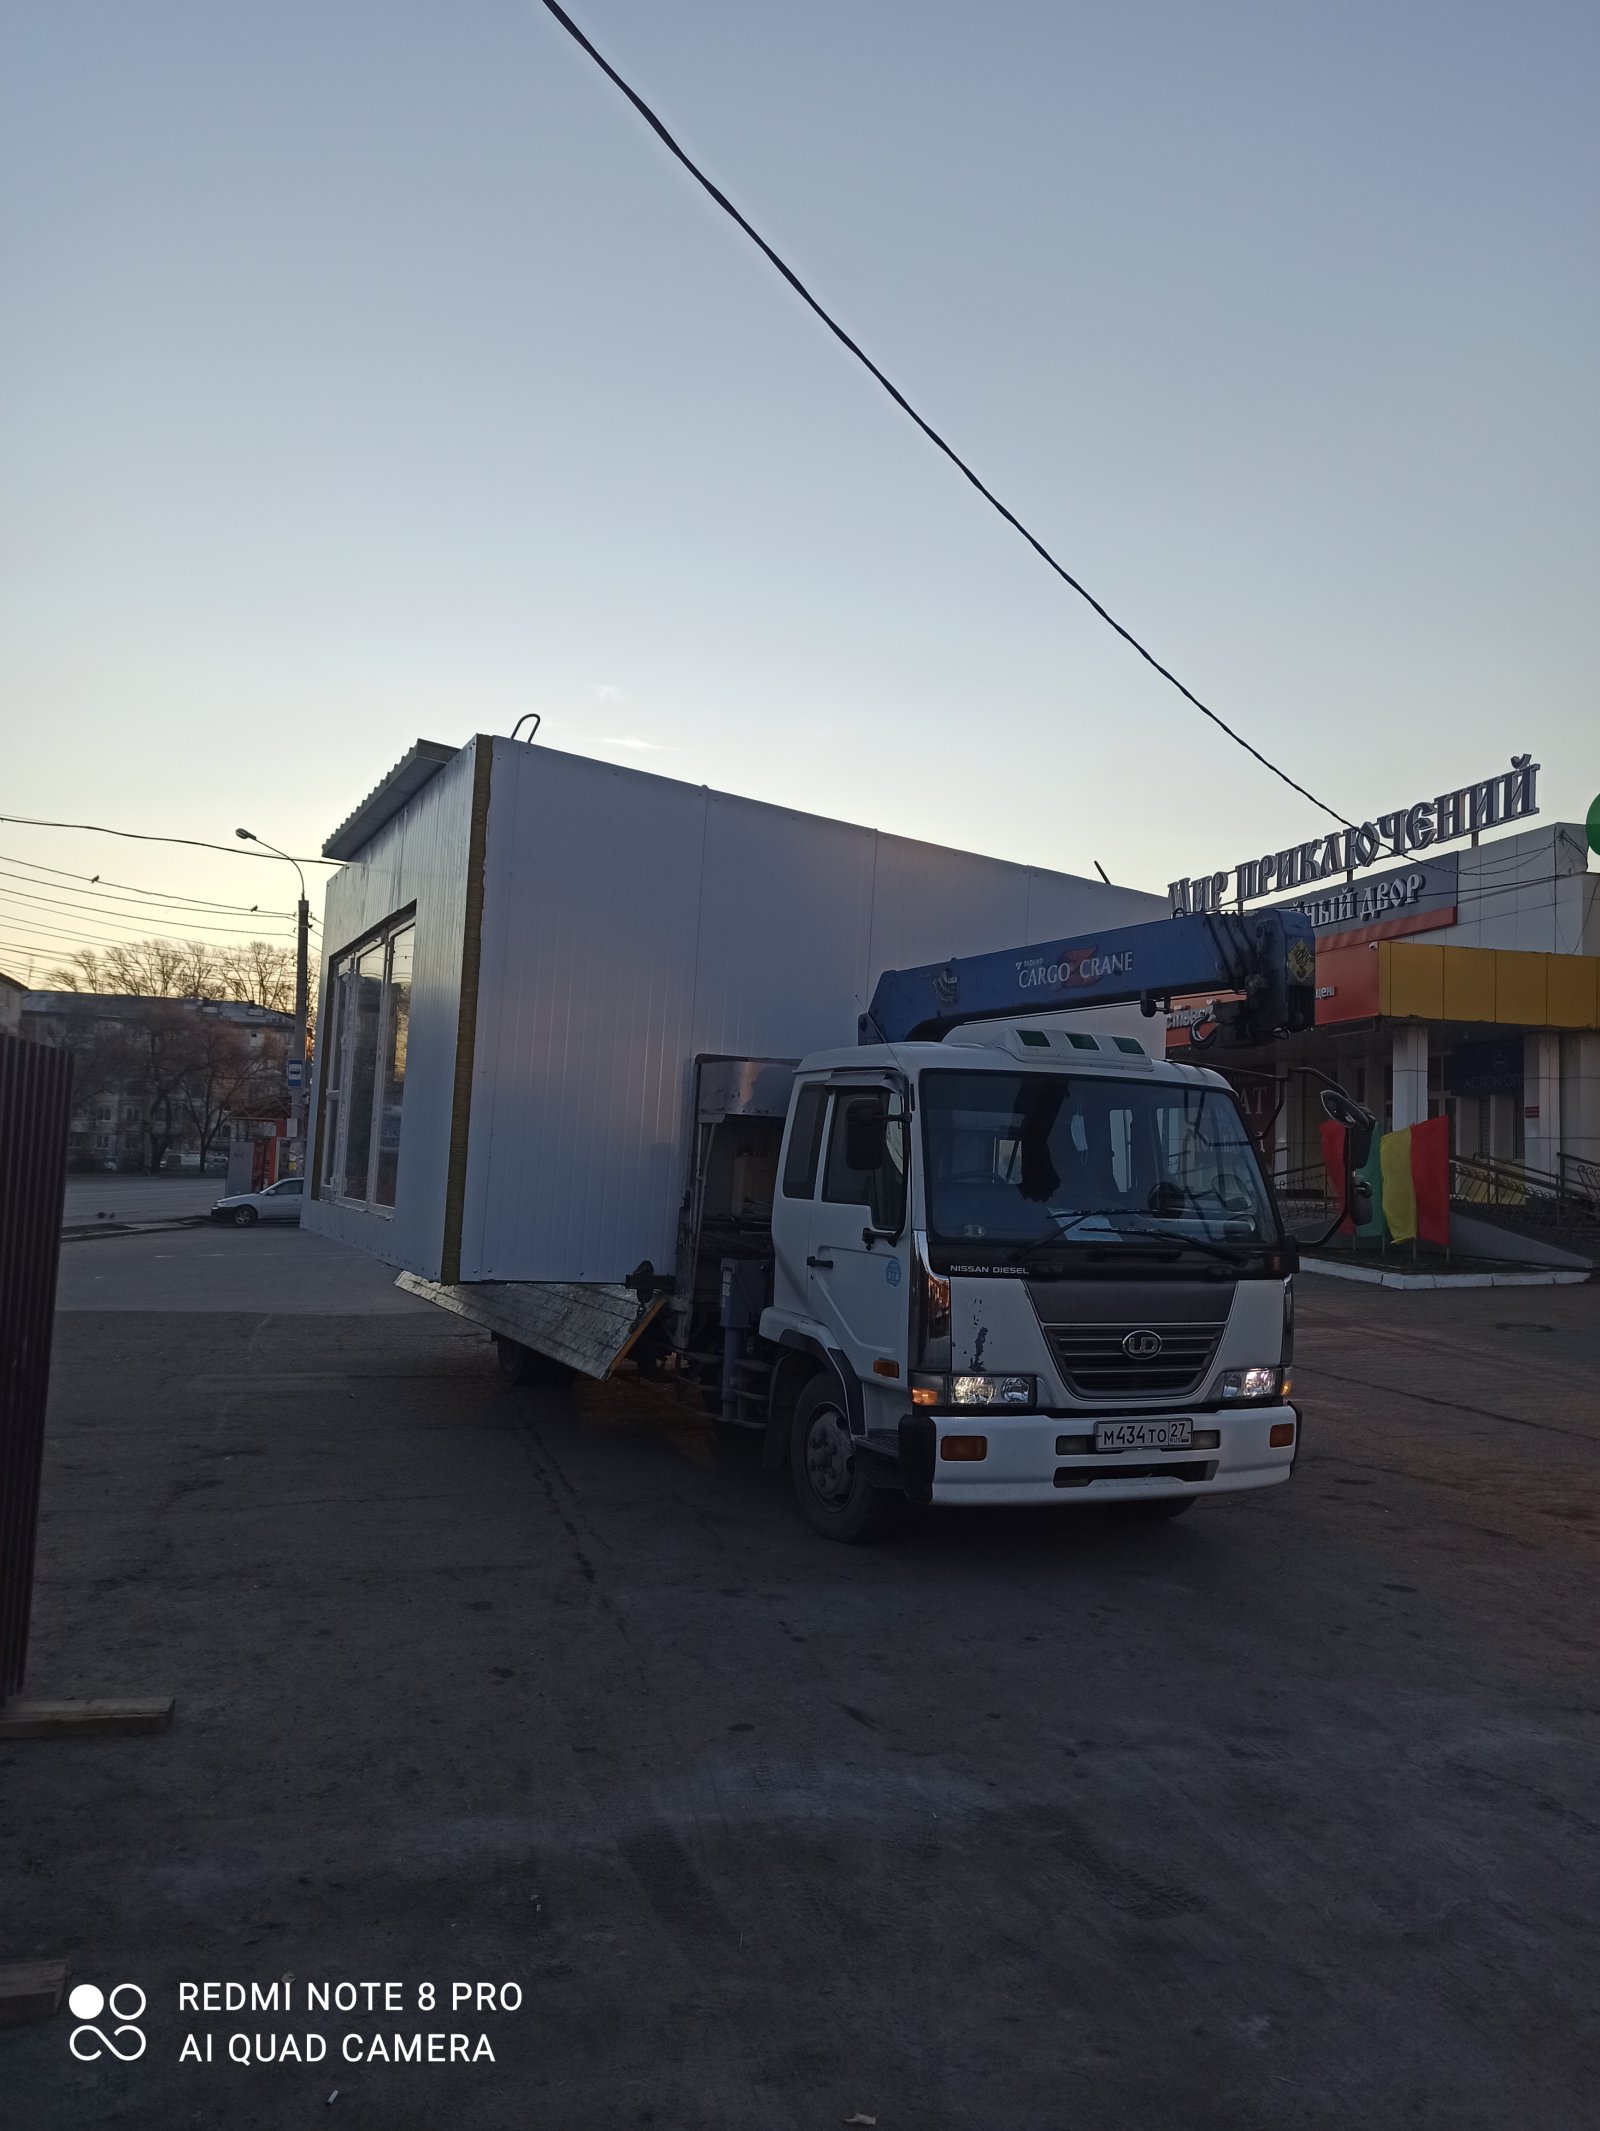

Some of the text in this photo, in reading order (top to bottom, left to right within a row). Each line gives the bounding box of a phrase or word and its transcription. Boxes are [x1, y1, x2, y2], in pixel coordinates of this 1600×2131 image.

[1235, 754, 1541, 905] ПРИКЛЮЧЕНИЙ
[1360, 873, 1424, 921] ДВОР
[1018, 951, 1133, 989] CARGO CRANE
[950, 1265, 1030, 1274] NISSAN DIESEL
[1128, 1337, 1159, 1354] UD
[1170, 1423, 1186, 1437] 27
